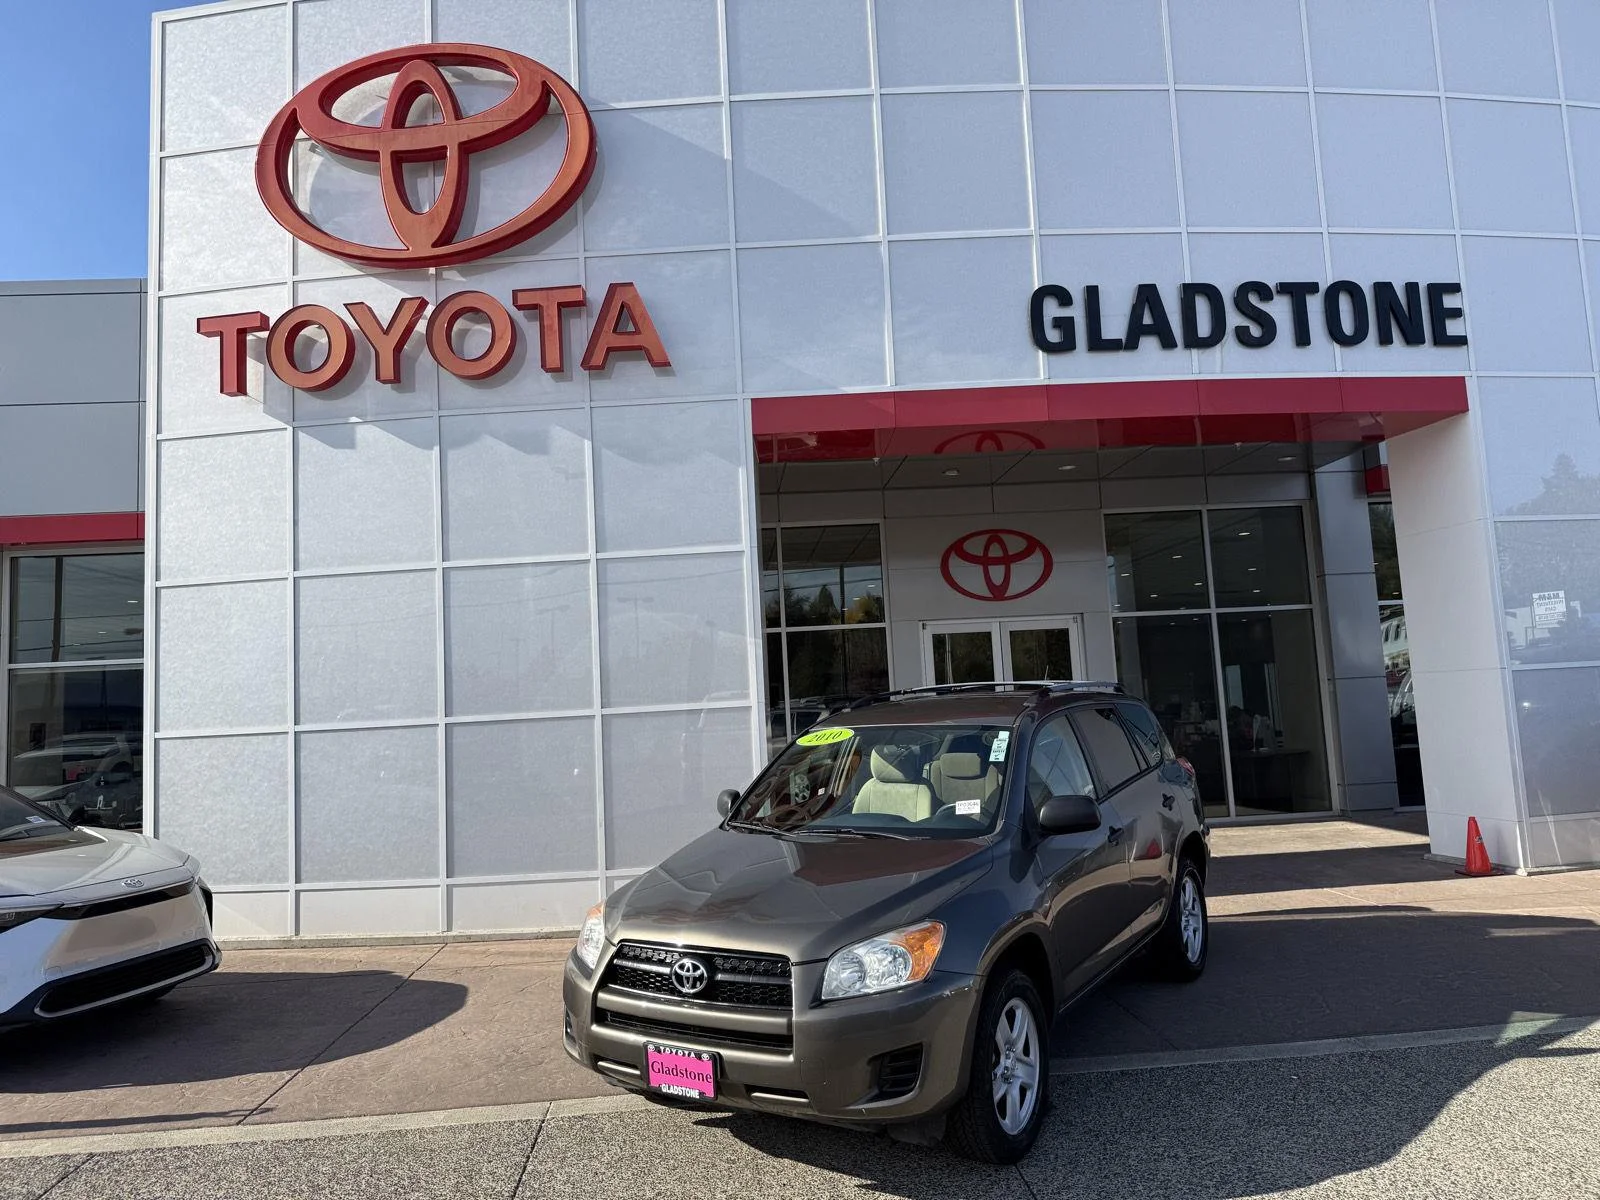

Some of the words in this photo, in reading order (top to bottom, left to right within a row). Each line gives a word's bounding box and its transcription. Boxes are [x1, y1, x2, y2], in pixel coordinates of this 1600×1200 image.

[1030, 281, 1468, 353] GLADSTONE
[197, 282, 671, 397] TOYOTA
[807, 731, 843, 743] 2010
[659, 1047, 696, 1058] TOYOTA
[651, 1060, 712, 1084] Gladstone
[661, 1084, 700, 1099] GLADSTONE
